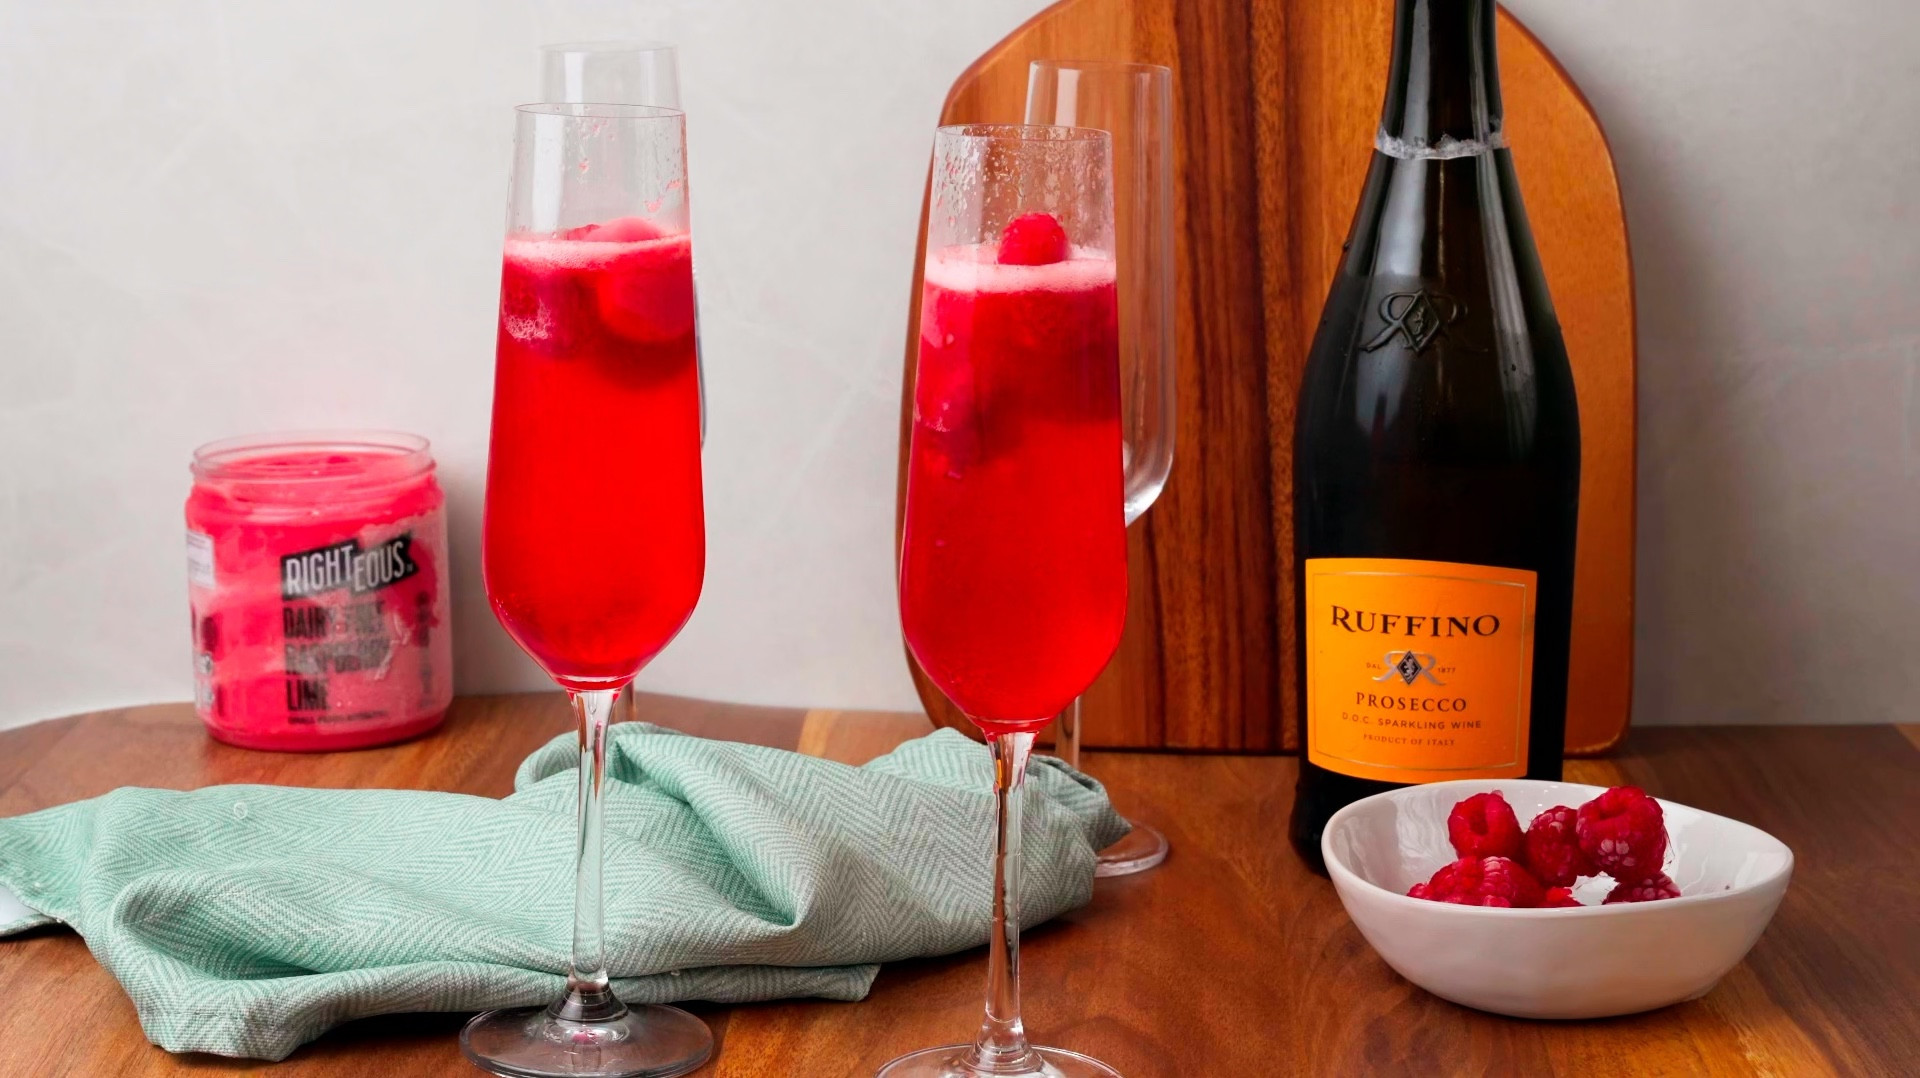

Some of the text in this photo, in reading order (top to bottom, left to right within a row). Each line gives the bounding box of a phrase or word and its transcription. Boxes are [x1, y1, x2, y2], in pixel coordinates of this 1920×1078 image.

[1331, 605, 1500, 637] RUFFINO
[1366, 662, 1381, 670] DAL
[1356, 692, 1467, 712] PROSECCO
[1378, 719, 1445, 730] SPARKLING
[1450, 720, 1482, 729] WINE
[1363, 734, 1455, 747] PRODUCT OF ITALY
